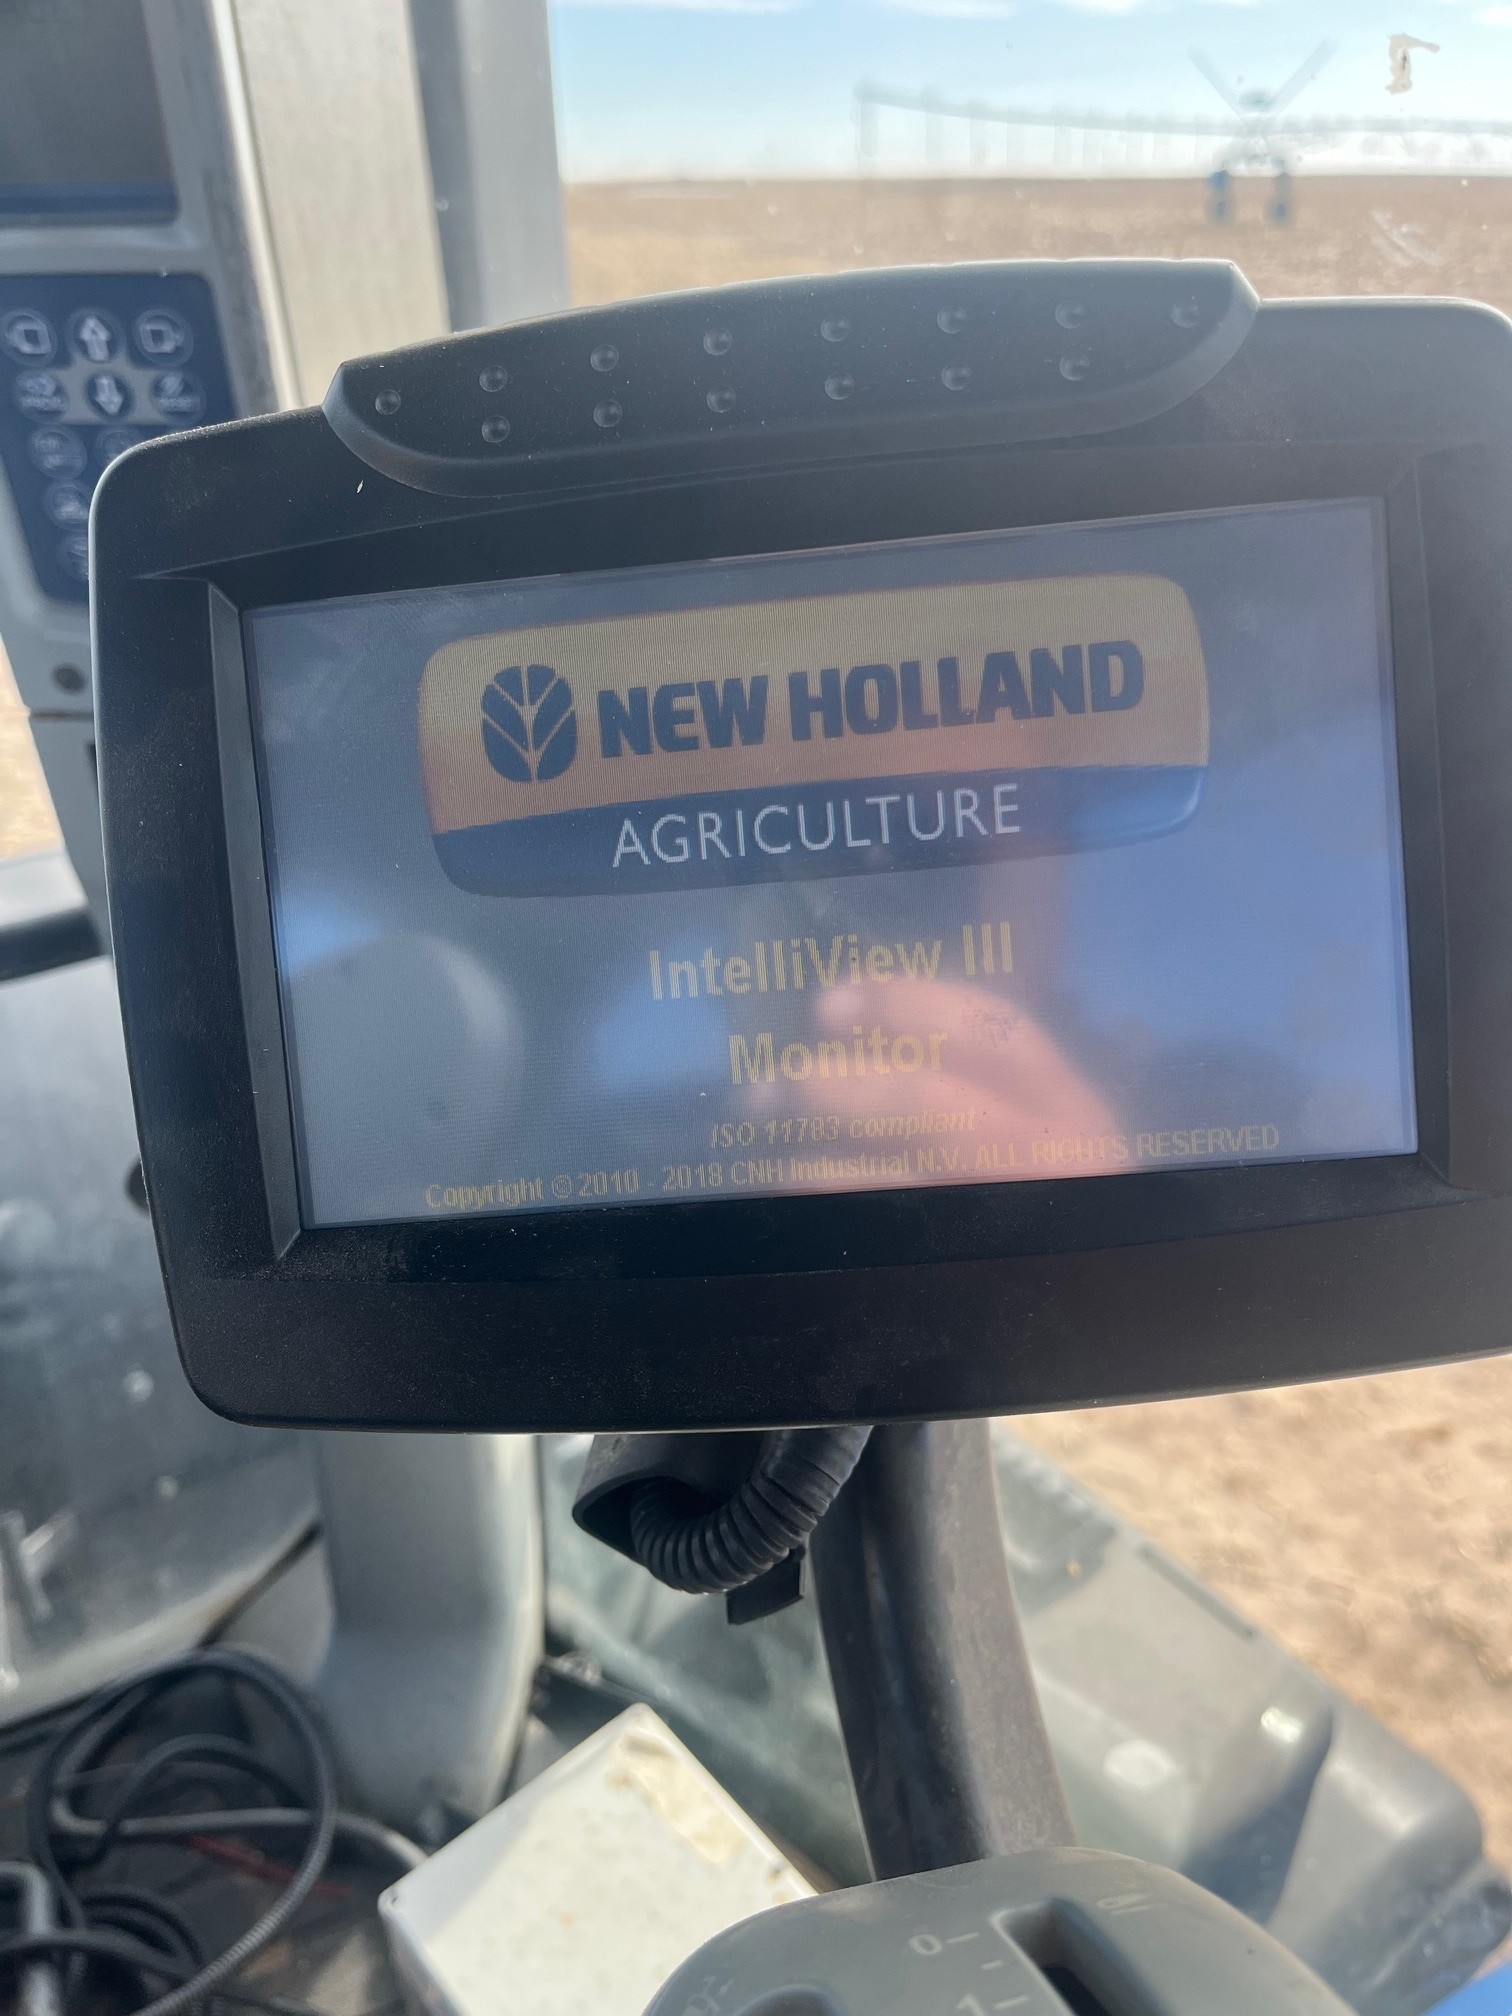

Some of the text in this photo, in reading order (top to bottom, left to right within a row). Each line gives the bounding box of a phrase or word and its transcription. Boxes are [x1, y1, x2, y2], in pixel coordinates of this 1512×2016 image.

[598, 639, 1146, 759] NEW HOLLAND
[612, 783, 1021, 869] AGRICULTURE
[649, 921, 1013, 1000] IntelliView III
[728, 1024, 949, 1086] Monitor
[425, 1175, 545, 1212] Copyright
[662, 1163, 724, 1192] 2018
[730, 1158, 784, 1187] CNH
[791, 1149, 910, 1182] Industrial
[916, 1146, 967, 1173] N.V.
[975, 1141, 1016, 1170] ALL
[1030, 1134, 1130, 1164] RIGHTS
[1137, 1123, 1281, 1159] RESERVED
[711, 1109, 977, 1149] ISO 11783 compliant
